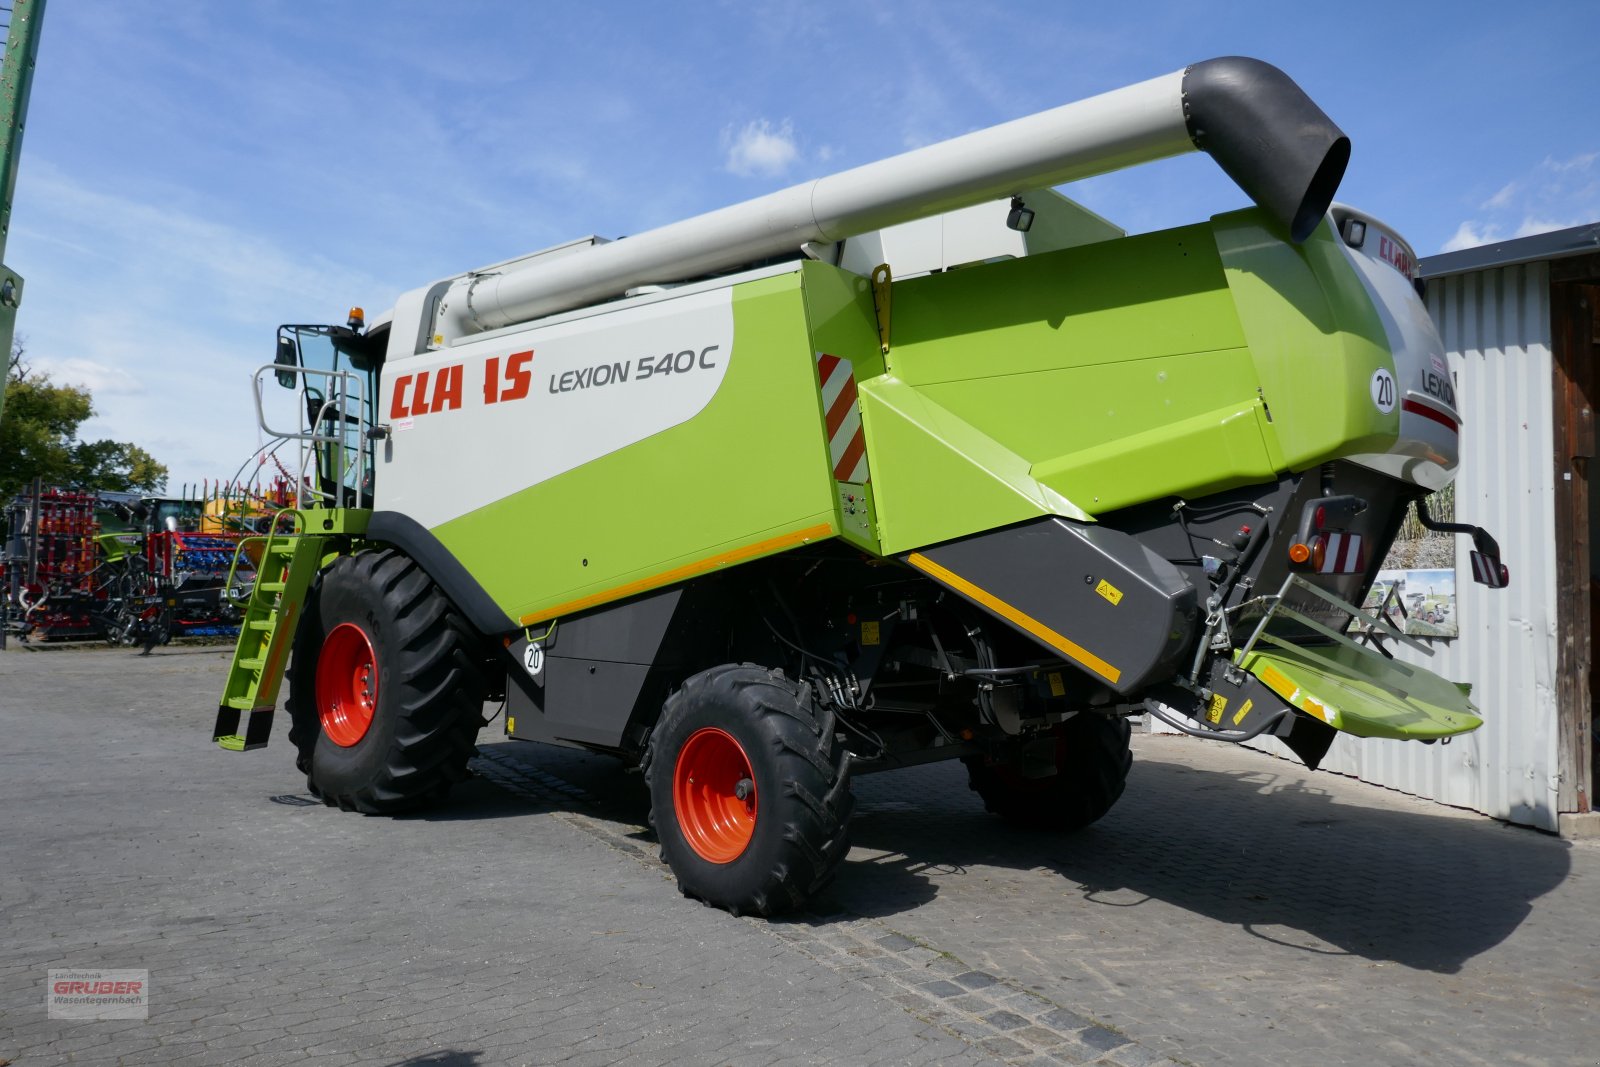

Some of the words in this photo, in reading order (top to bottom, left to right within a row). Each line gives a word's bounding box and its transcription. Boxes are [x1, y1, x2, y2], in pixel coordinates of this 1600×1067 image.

[549, 360, 630, 395] LEXION
[635, 350, 695, 381] 540
[1376, 375, 1393, 407] 20
[528, 648, 540, 669] 20
